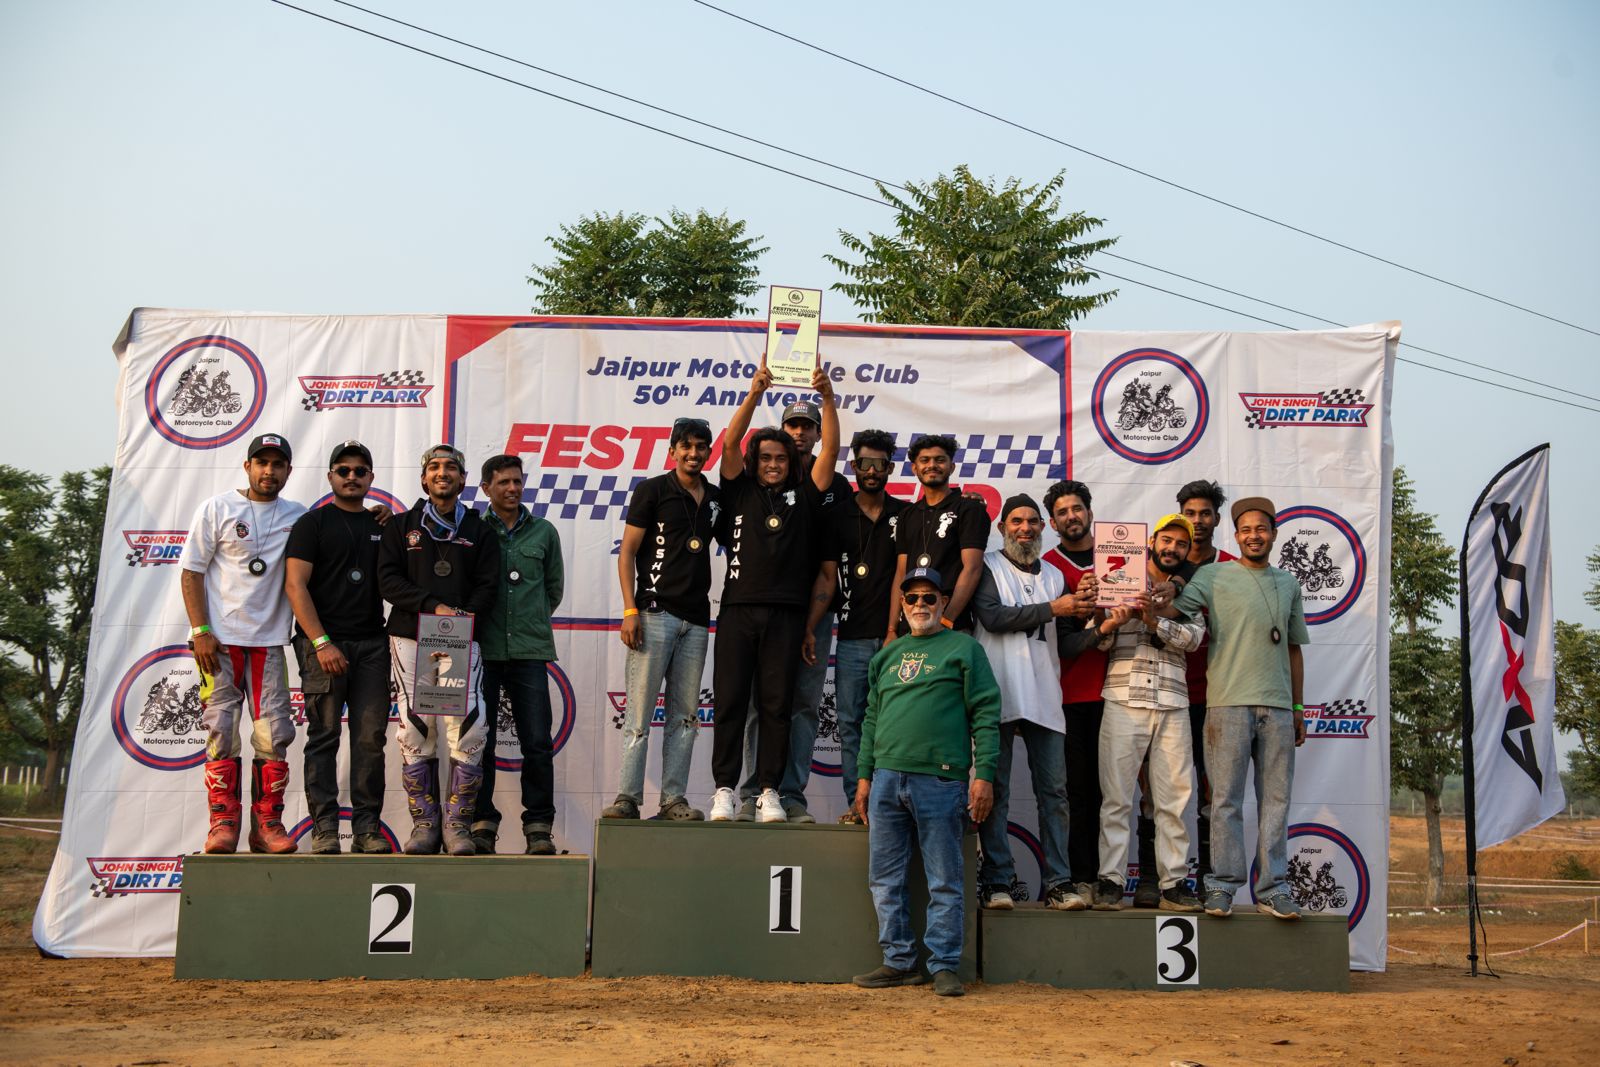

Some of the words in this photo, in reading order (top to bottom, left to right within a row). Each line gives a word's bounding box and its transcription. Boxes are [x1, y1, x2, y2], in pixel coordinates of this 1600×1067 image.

[199, 357, 220, 365] Jaipur
[586, 356, 682, 380] Jaipur
[855, 363, 919, 385] Club
[1139, 370, 1162, 378] Jaipur
[309, 380, 340, 390] JOHN
[341, 380, 376, 389] SINGH
[323, 389, 369, 403] DIRT
[370, 389, 422, 403] PARK
[1250, 398, 1282, 407] JOHN
[1283, 398, 1317, 407] SINGH
[1264, 408, 1309, 422] DIRT
[1311, 409, 1363, 422] PARK
[134, 535, 167, 545] JOHN
[149, 545, 184, 559] DIR
[729, 515, 743, 580] SUJAN
[840, 552, 852, 621] SHIVAM
[169, 669, 193, 677] Jaipur
[1315, 720, 1364, 733] PARK
[143, 738, 186, 746] Motorcycle
[100, 863, 134, 872] JOHN
[136, 863, 175, 872] SINGH
[114, 873, 166, 888] DIRT
[771, 867, 799, 932] 1
[370, 884, 412, 953] 2
[1158, 917, 1197, 983] 3
